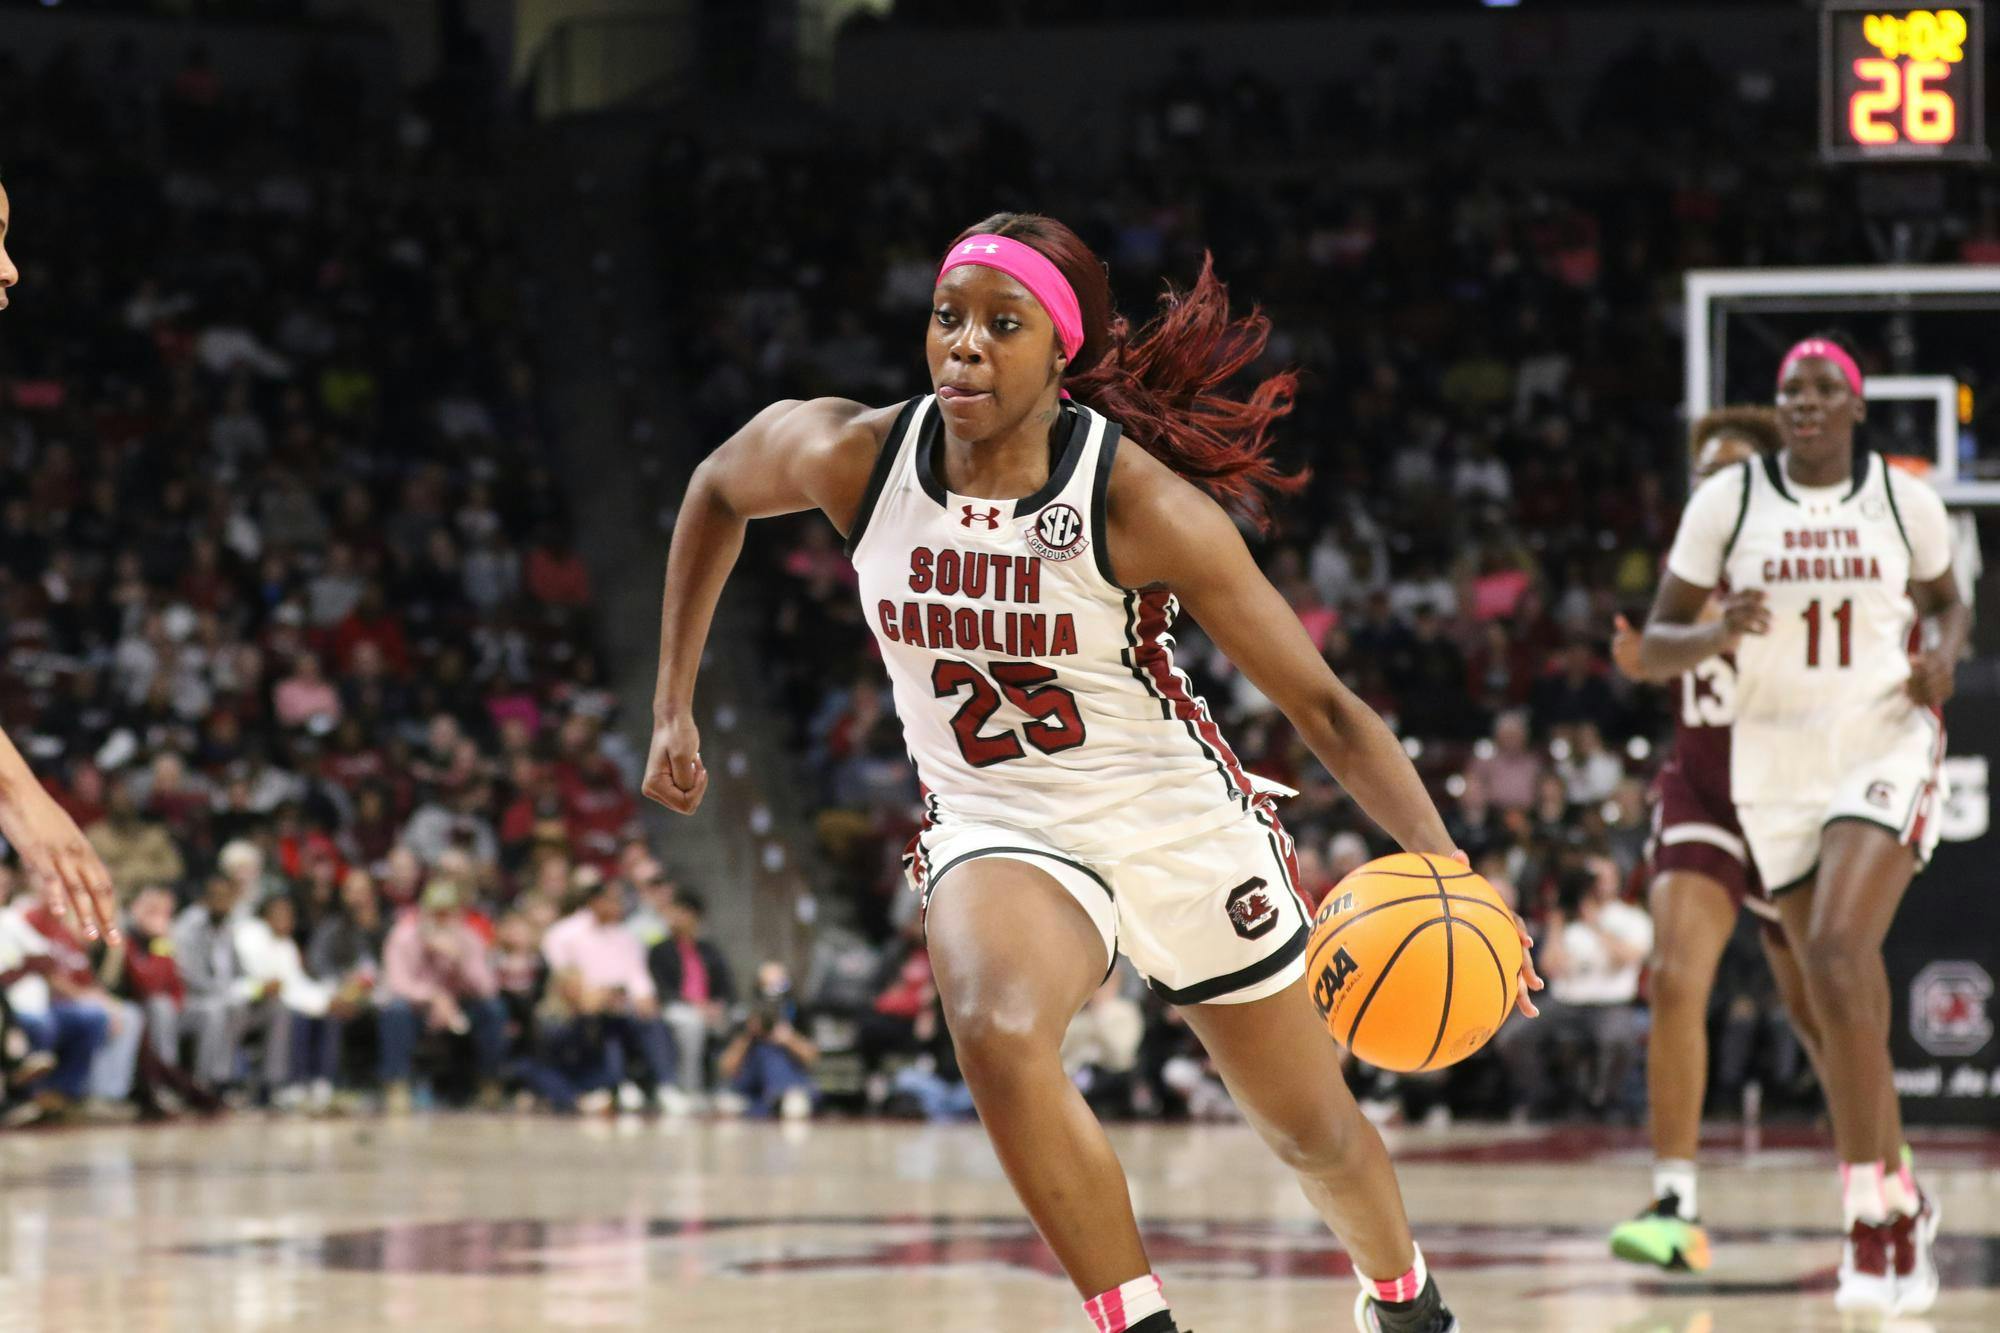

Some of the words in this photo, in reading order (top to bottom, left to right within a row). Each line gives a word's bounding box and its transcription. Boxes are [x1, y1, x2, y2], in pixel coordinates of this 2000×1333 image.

[1863, 10, 1967, 62] 4:02
[1850, 58, 1955, 144] 26
[1031, 538, 1080, 560] GRADUATE
[1040, 506, 1080, 547] SEC
[1783, 528, 1860, 550] SOUTH
[908, 546, 1041, 604] SOUTH
[1761, 556, 1882, 583] CAROLINA
[877, 599, 1079, 658] CAROLINA
[1800, 599, 1852, 668] 11
[931, 658, 1087, 768] 25
[1682, 655, 1738, 728] 13
